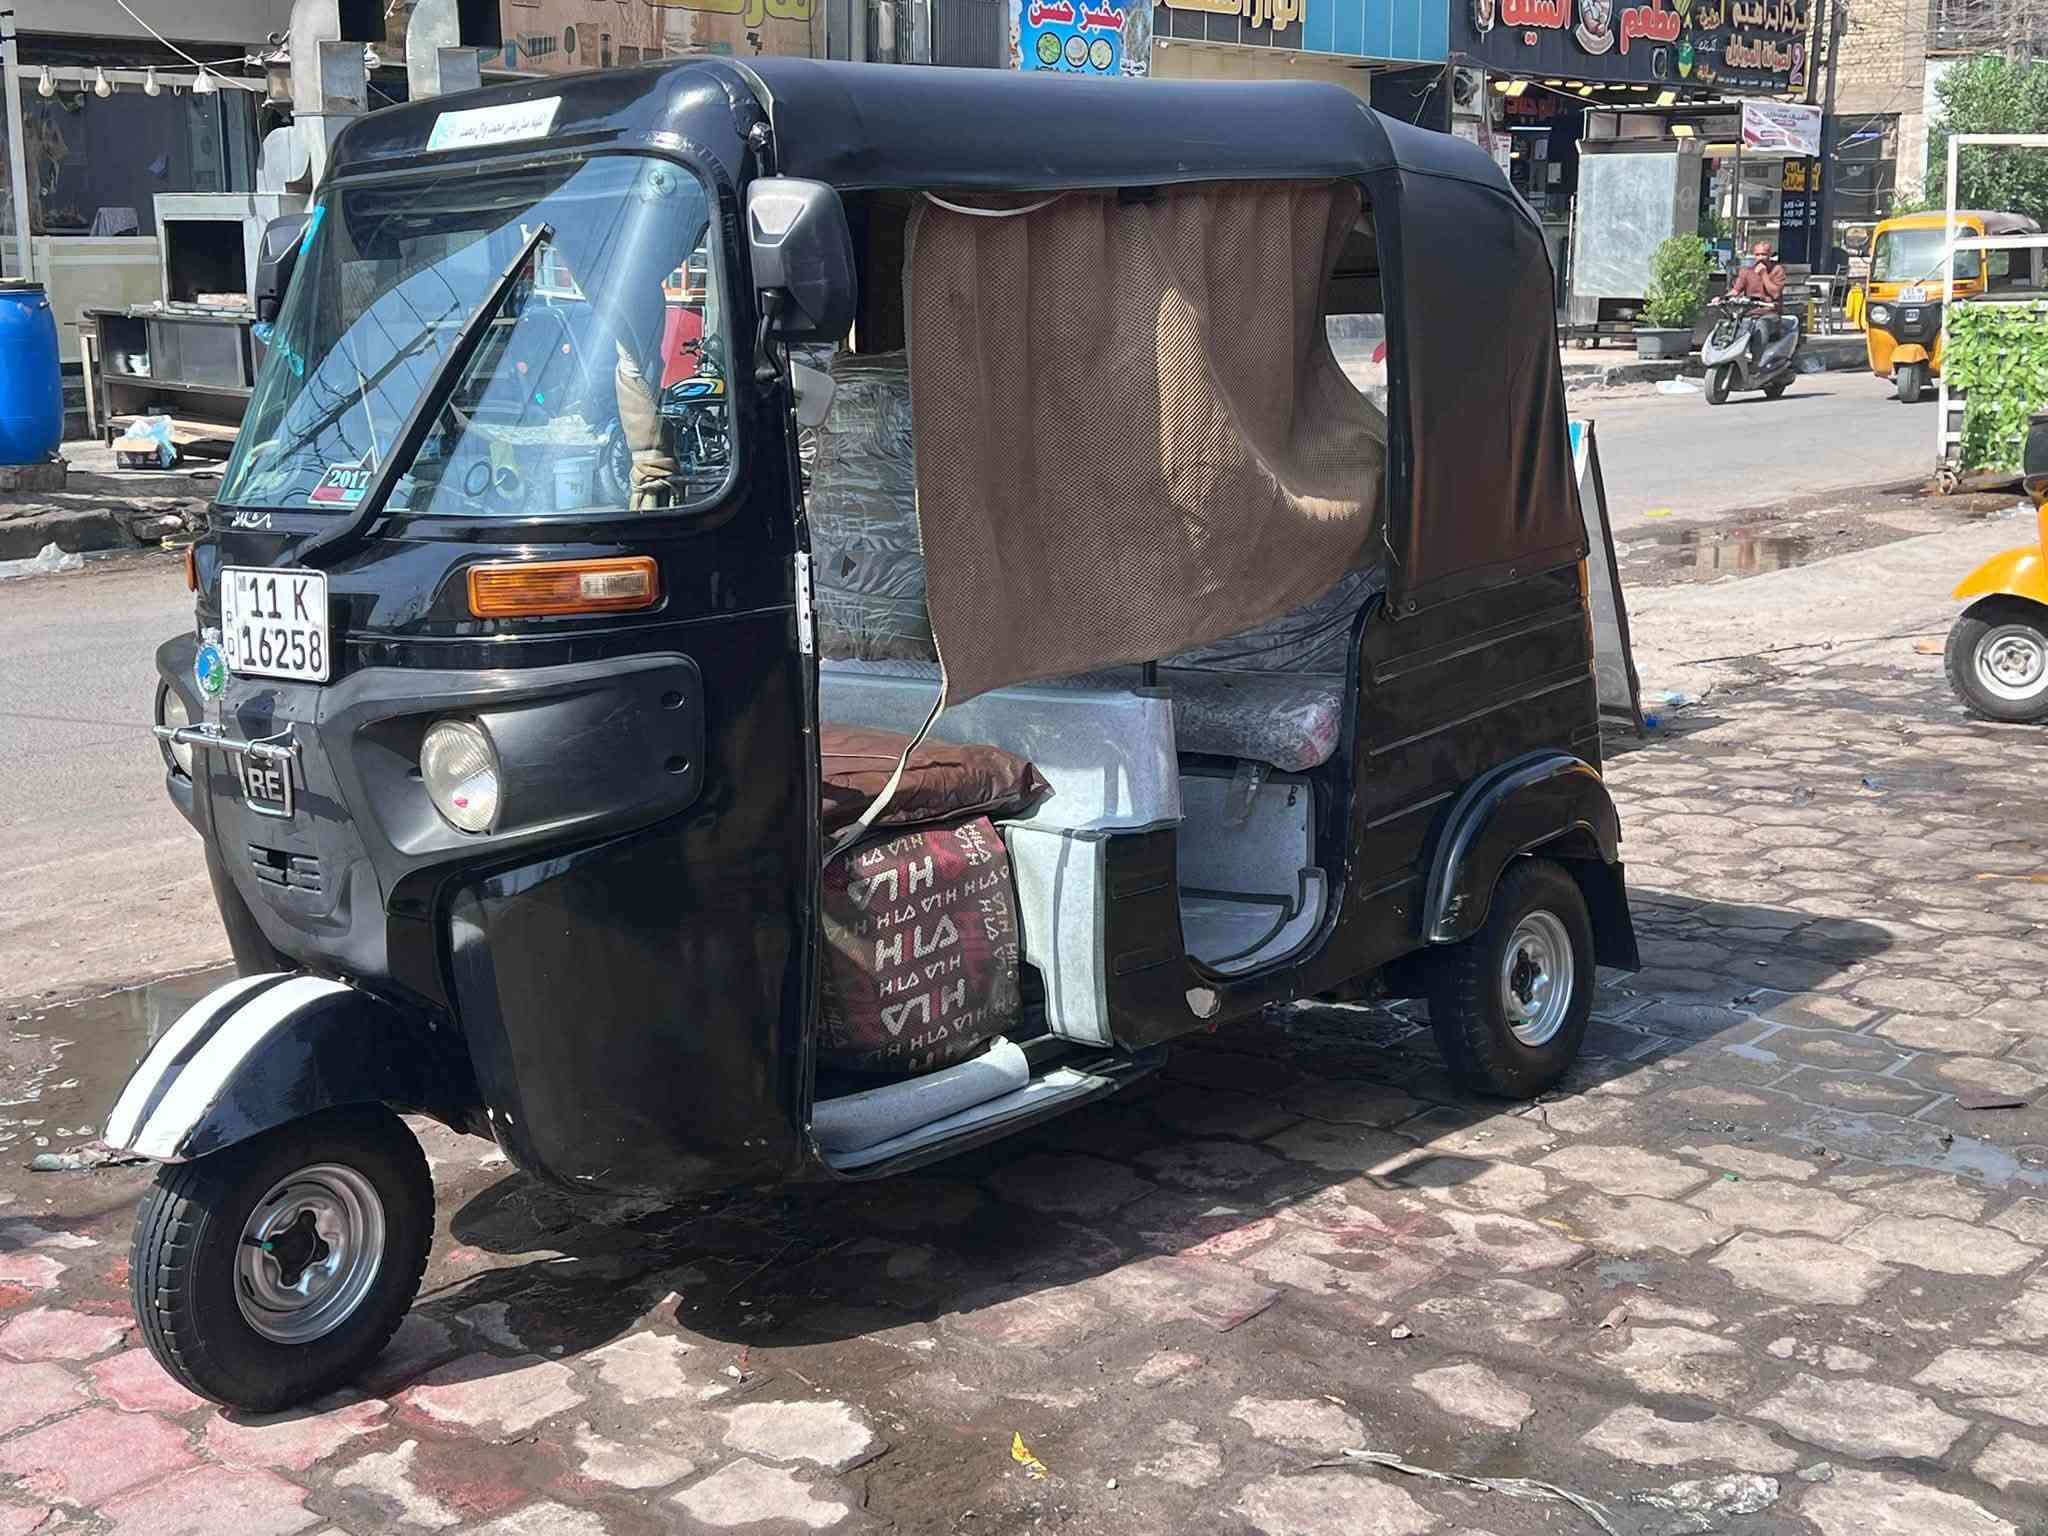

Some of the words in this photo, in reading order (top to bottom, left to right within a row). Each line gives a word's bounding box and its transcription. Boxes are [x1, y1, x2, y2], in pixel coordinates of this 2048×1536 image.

[1619, 0, 1681, 55] مطعم
[327, 470, 372, 489] 2017
[249, 577, 282, 619] 11
[292, 578, 309, 621] K
[241, 625, 323, 673] 16258
[247, 768, 285, 801] RE
